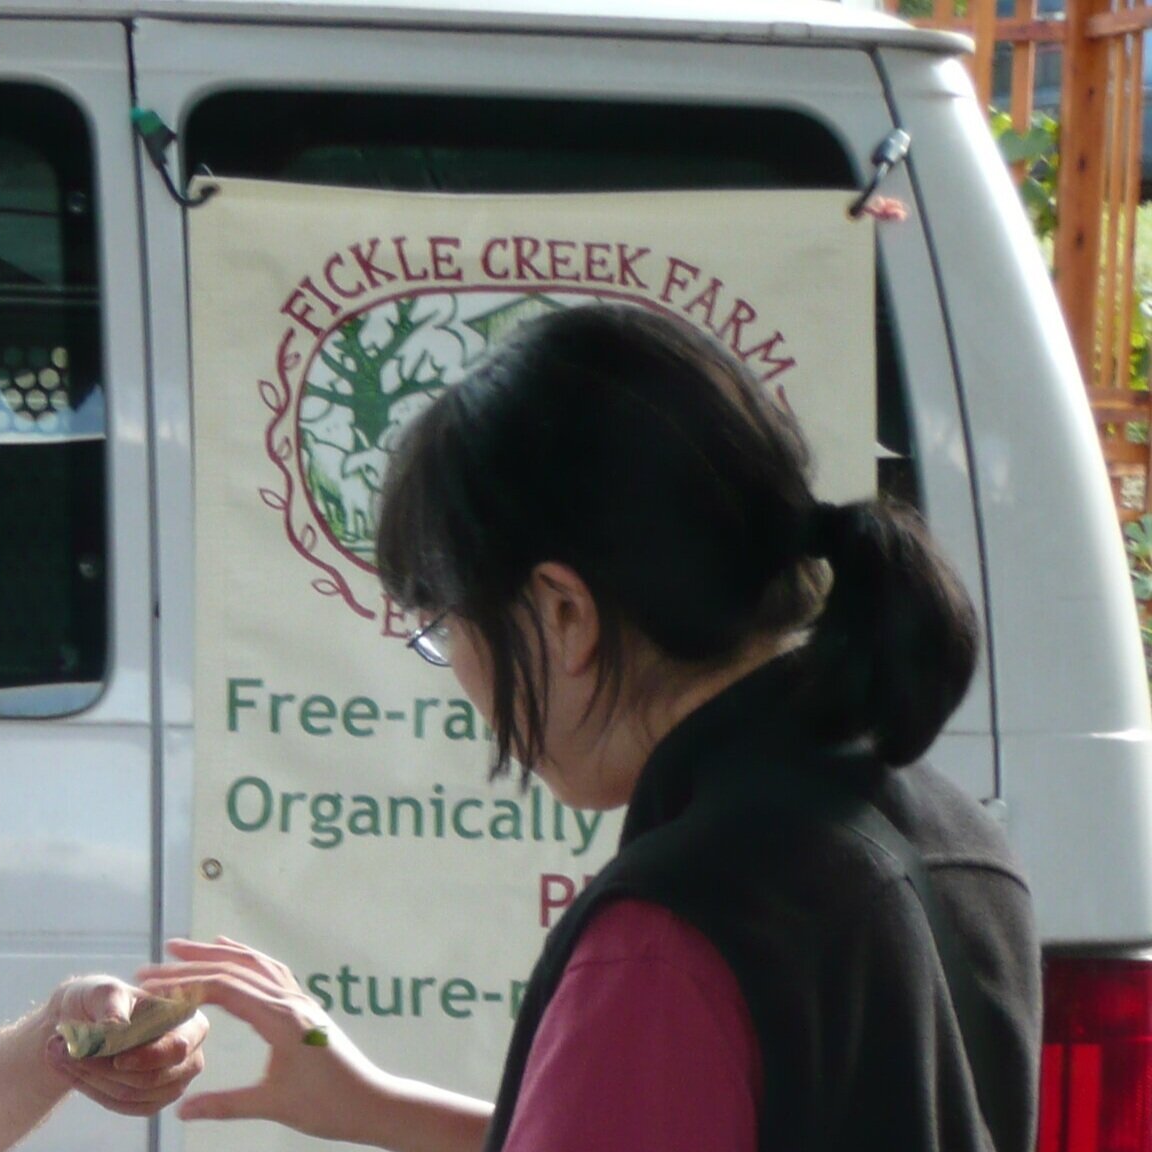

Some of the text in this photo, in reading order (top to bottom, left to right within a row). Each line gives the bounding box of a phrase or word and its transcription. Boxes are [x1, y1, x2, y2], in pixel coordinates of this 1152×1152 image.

[279, 236, 796, 382] FICKLE CREEK FARM
[226, 677, 492, 739] Free-ra
[226, 776, 603, 856] Organically
